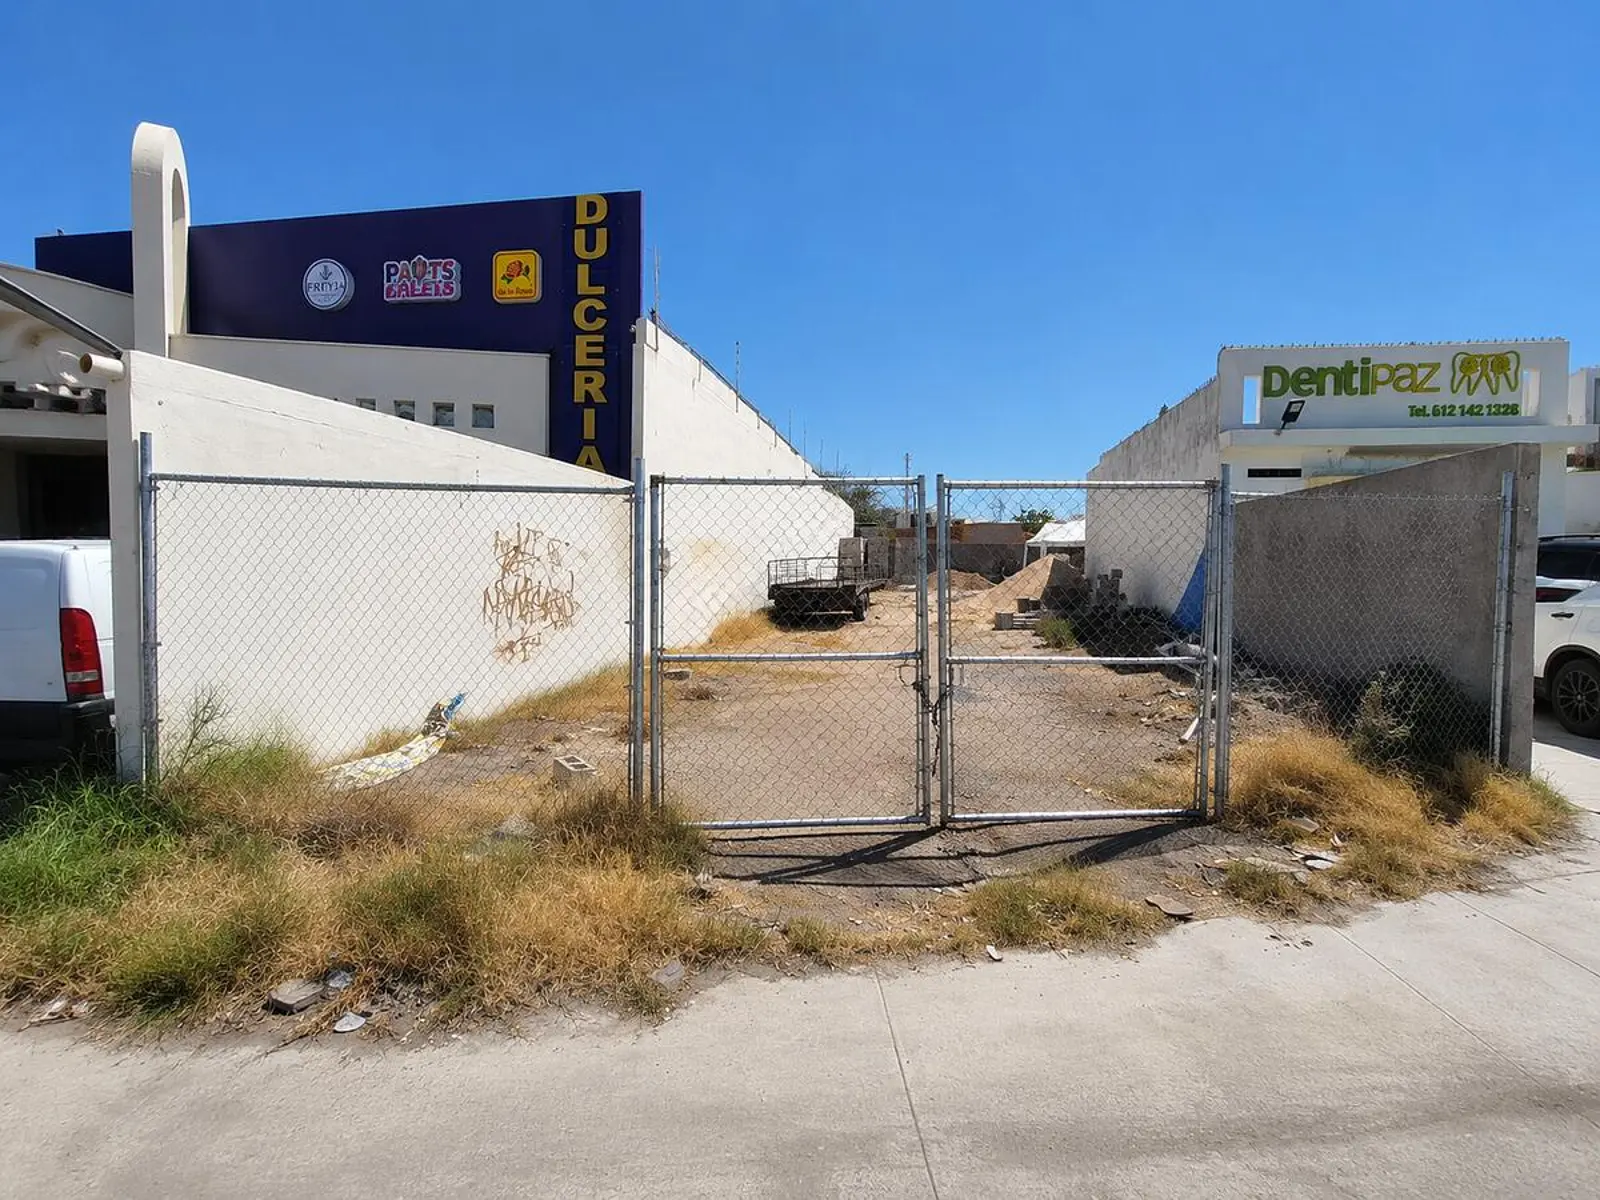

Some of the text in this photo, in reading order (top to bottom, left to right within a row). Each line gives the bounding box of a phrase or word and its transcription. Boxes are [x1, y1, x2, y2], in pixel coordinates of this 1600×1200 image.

[573, 194, 608, 473] DULCERIA
[1263, 357, 1441, 398] Dentipaz
[1408, 404, 1431, 417] Tel.
[1432, 404, 1457, 417] 612
[1459, 404, 1484, 417] 142
